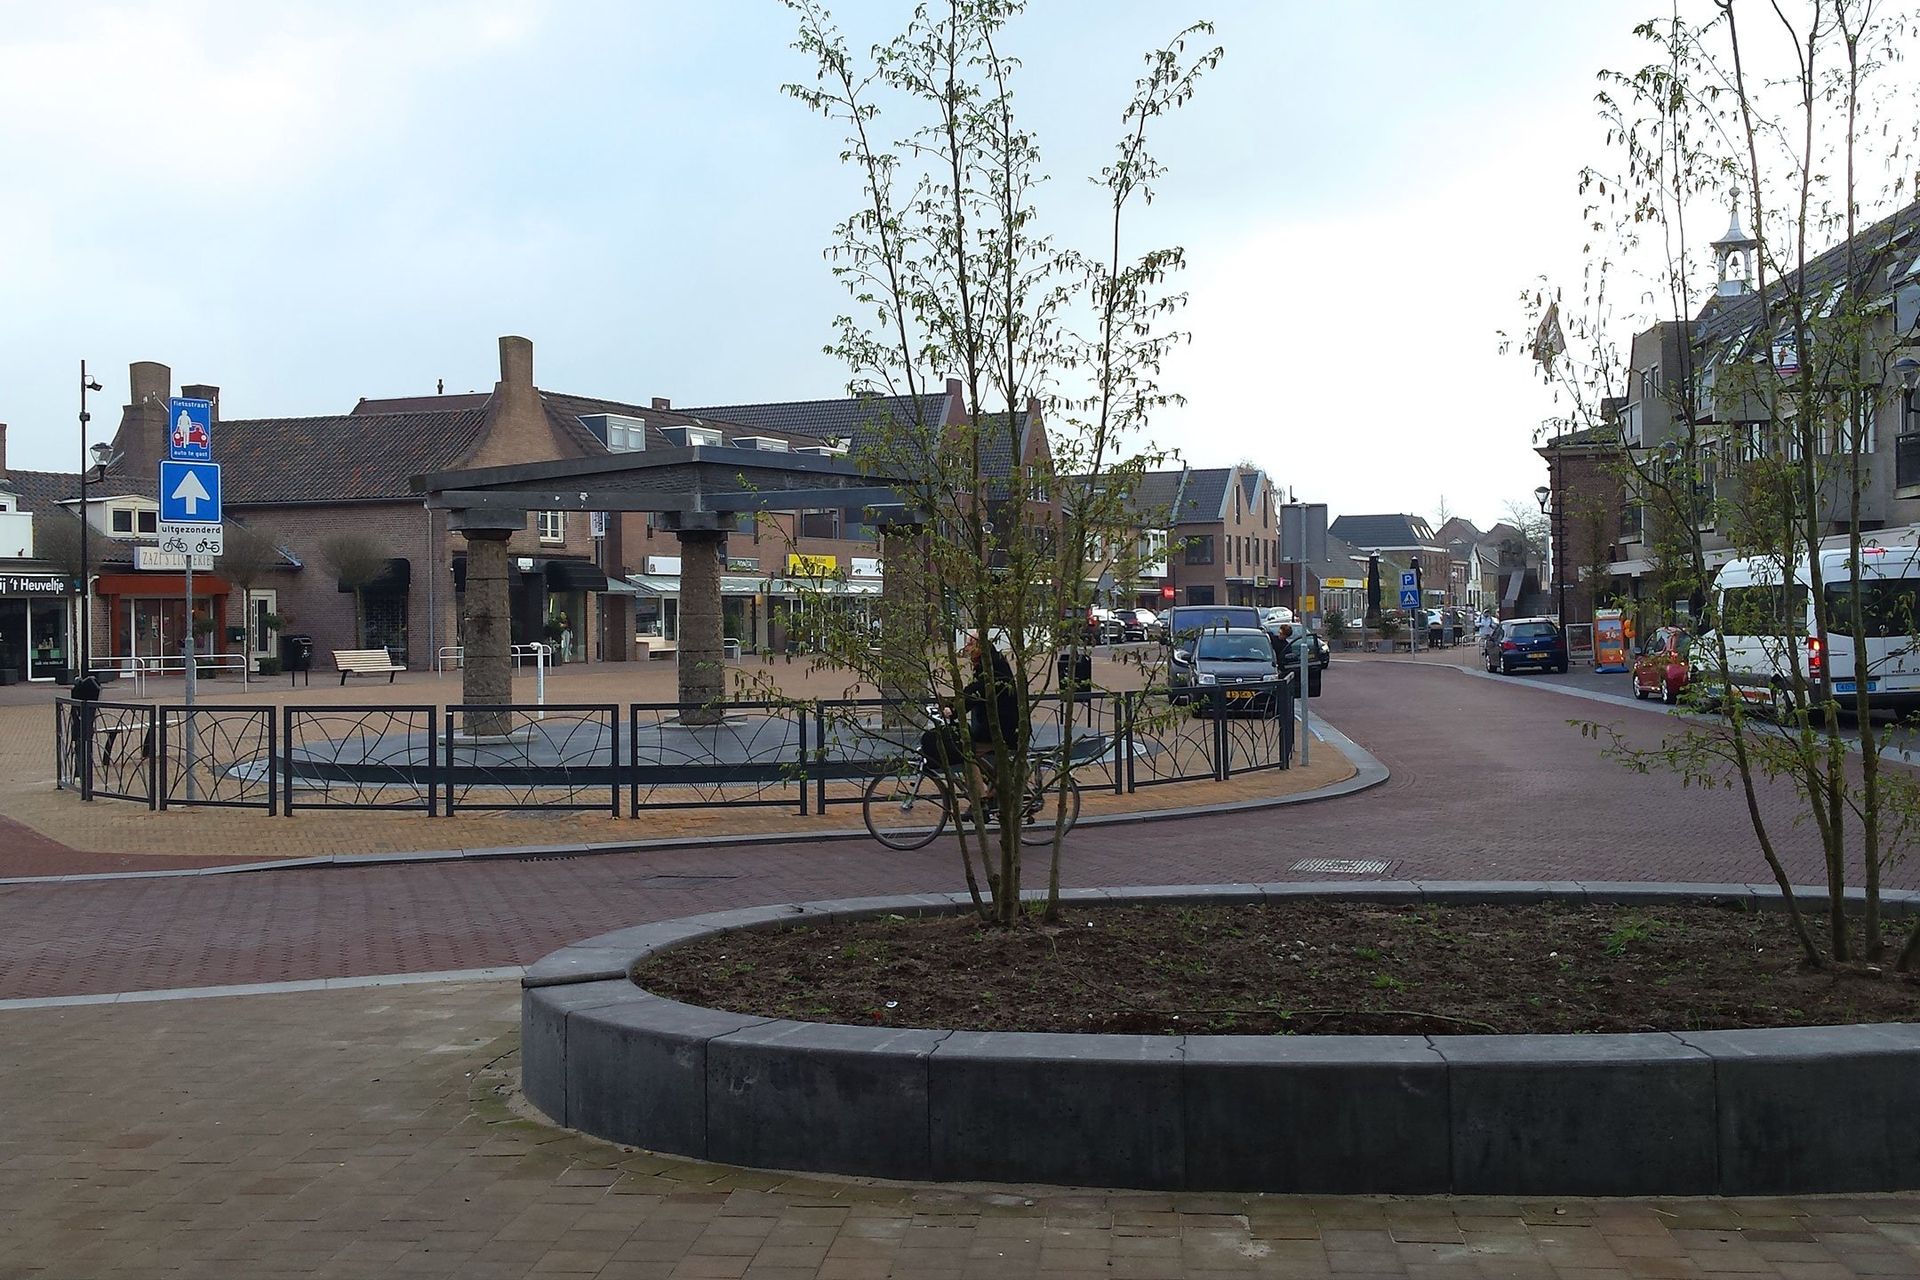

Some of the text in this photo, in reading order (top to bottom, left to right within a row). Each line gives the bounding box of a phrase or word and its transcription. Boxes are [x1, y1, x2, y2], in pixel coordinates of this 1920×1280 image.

[161, 525, 221, 535] uitgezonderd
[172, 553, 212, 566] LINERIE
[1404, 575, 1412, 584] P
[9, 578, 18, 591] 't
[20, 577, 64, 594] Heuveltje
